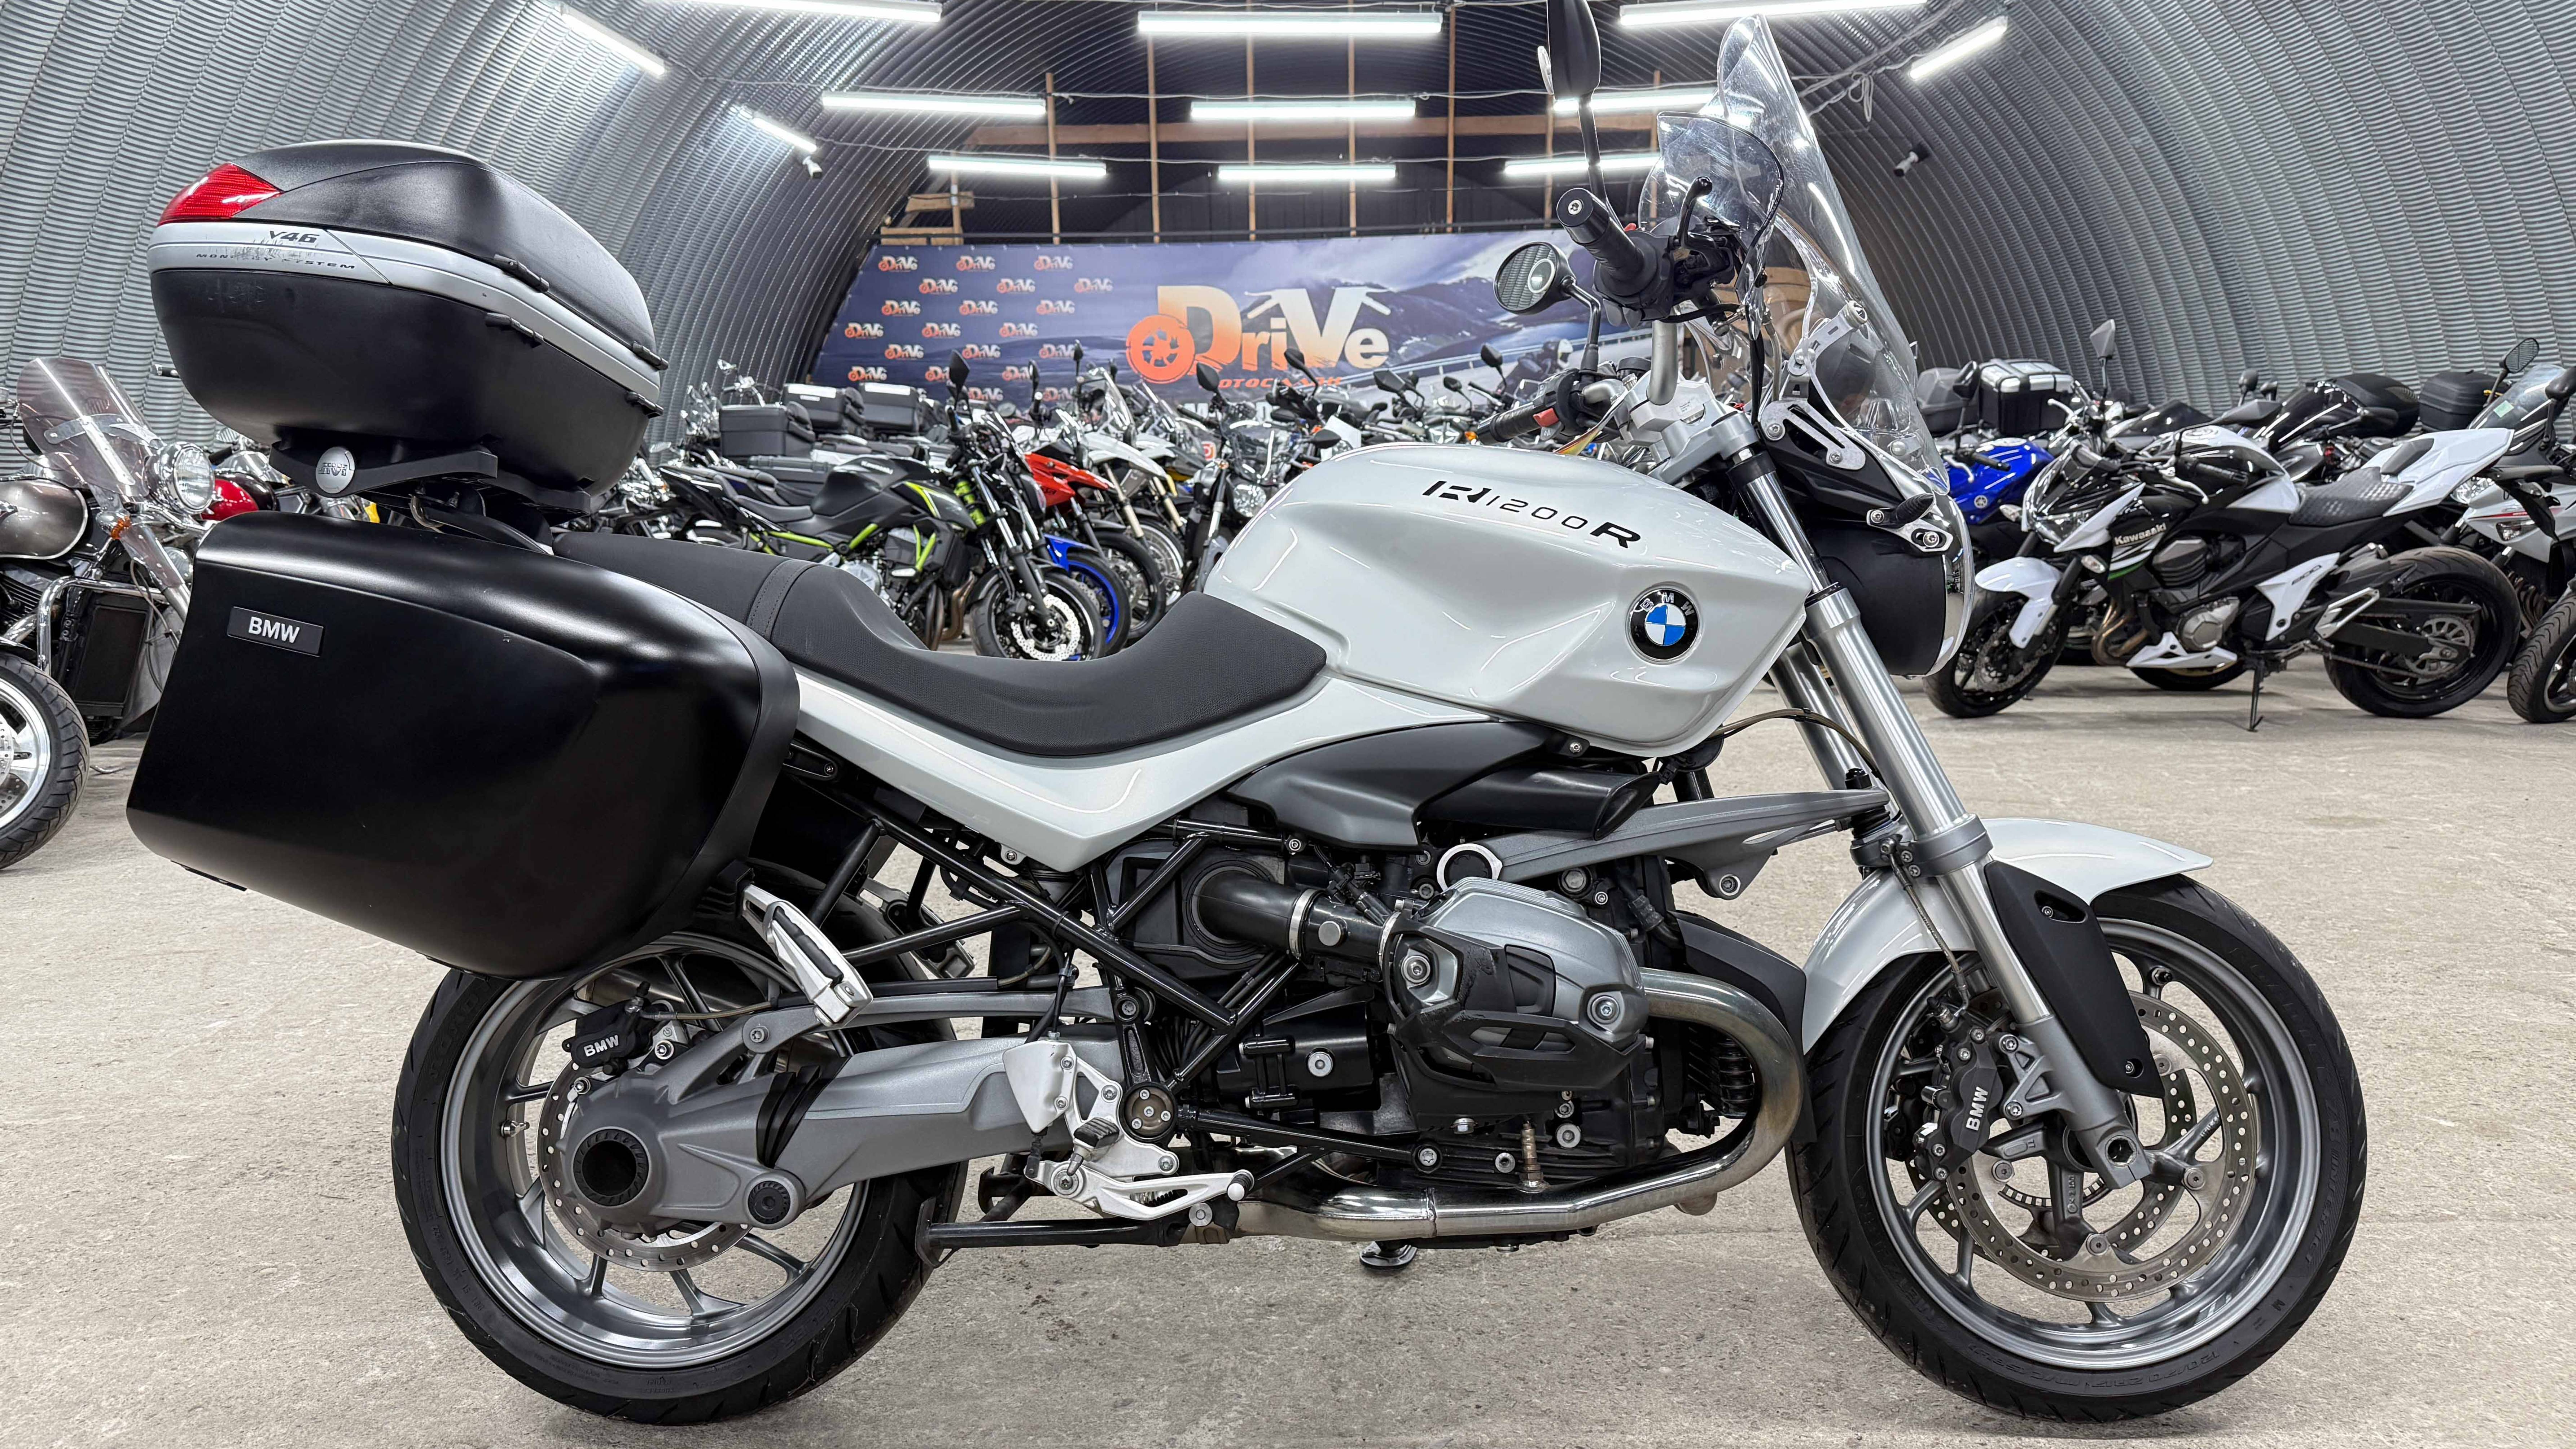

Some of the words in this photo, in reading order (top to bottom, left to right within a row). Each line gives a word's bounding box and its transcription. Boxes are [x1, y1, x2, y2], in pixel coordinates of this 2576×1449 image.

[270, 231, 320, 243] V46
[2114, 522, 2167, 545] Kawasaki
[1639, 592, 1695, 617] BMW
[248, 616, 300, 643] BMW
[583, 1035, 619, 1057] BMW
[1966, 1086, 1988, 1131] BMW
